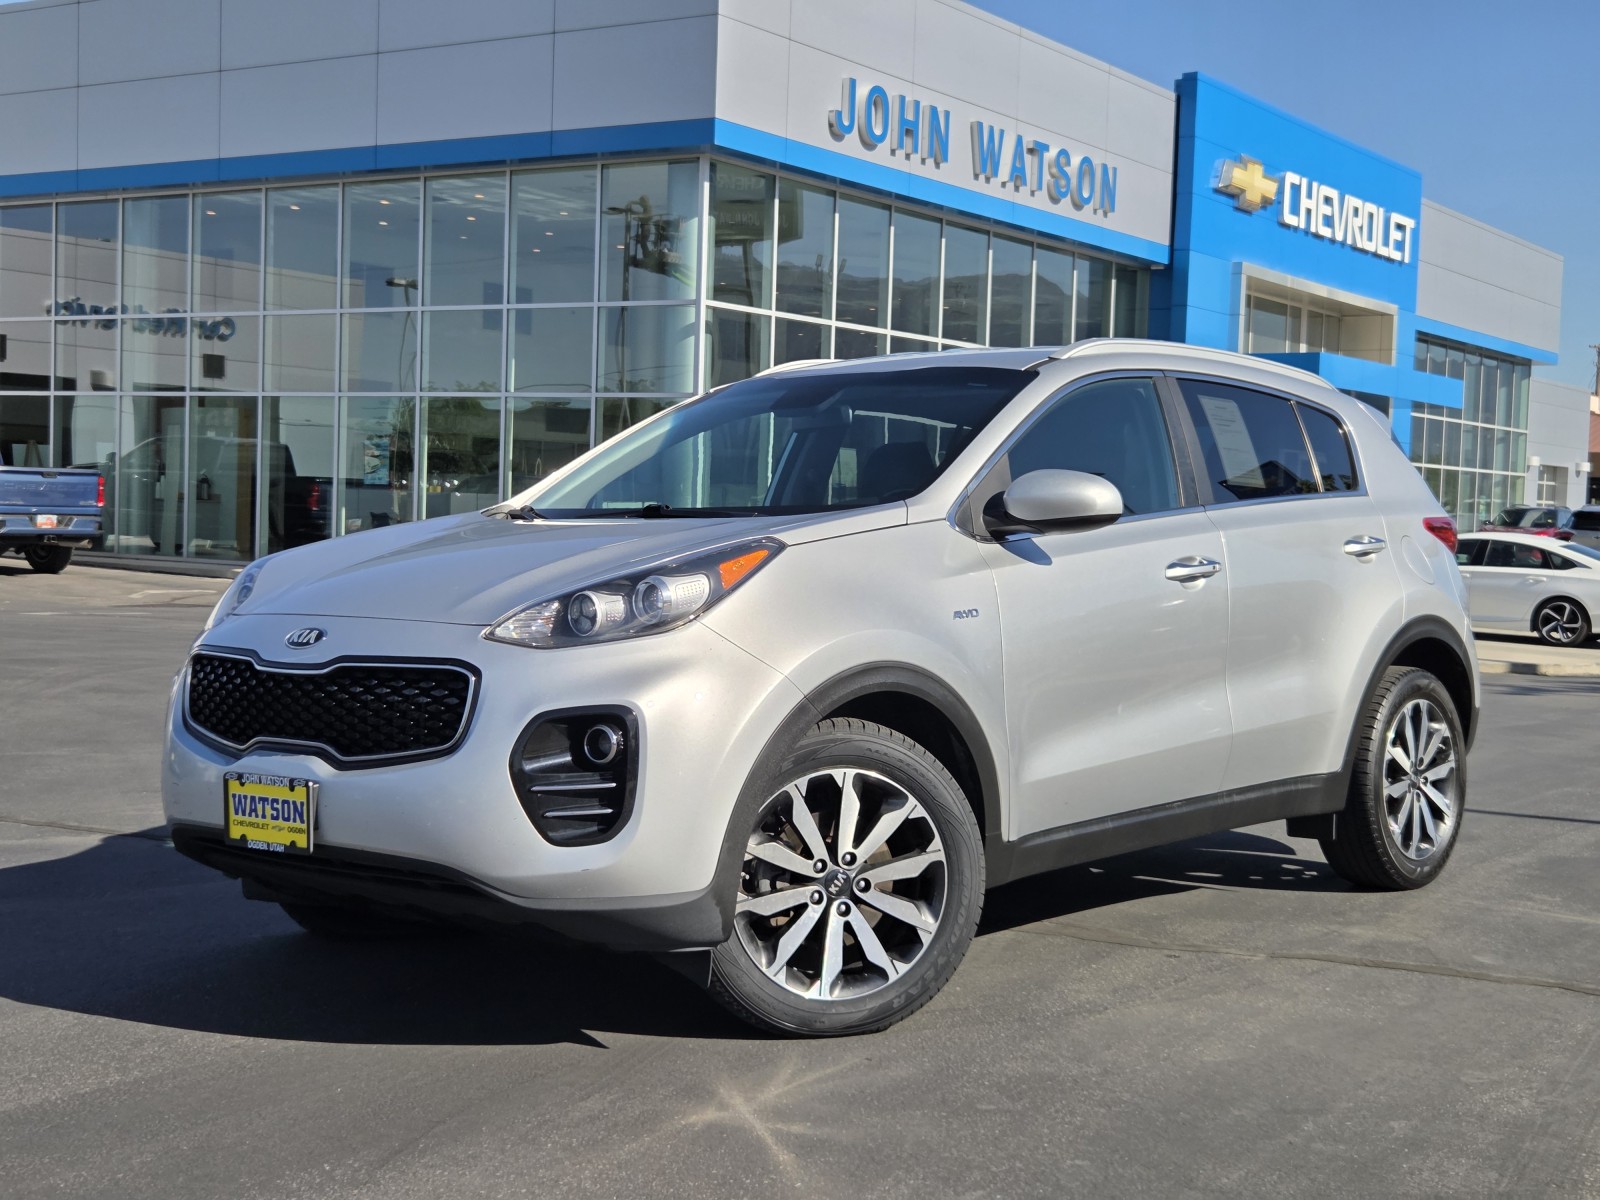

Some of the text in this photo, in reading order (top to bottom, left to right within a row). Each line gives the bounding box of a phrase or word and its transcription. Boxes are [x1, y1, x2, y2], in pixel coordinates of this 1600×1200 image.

[828, 77, 1117, 216] JOHN WATSON
[1278, 171, 1415, 263] CHEVROLET
[289, 629, 319, 644] KIA
[241, 773, 290, 787] JOHN WATSON
[232, 793, 305, 824] WATSON
[233, 819, 269, 830] CHEVROLET
[269, 843, 285, 852] UTAH
[828, 872, 847, 895] KIA
